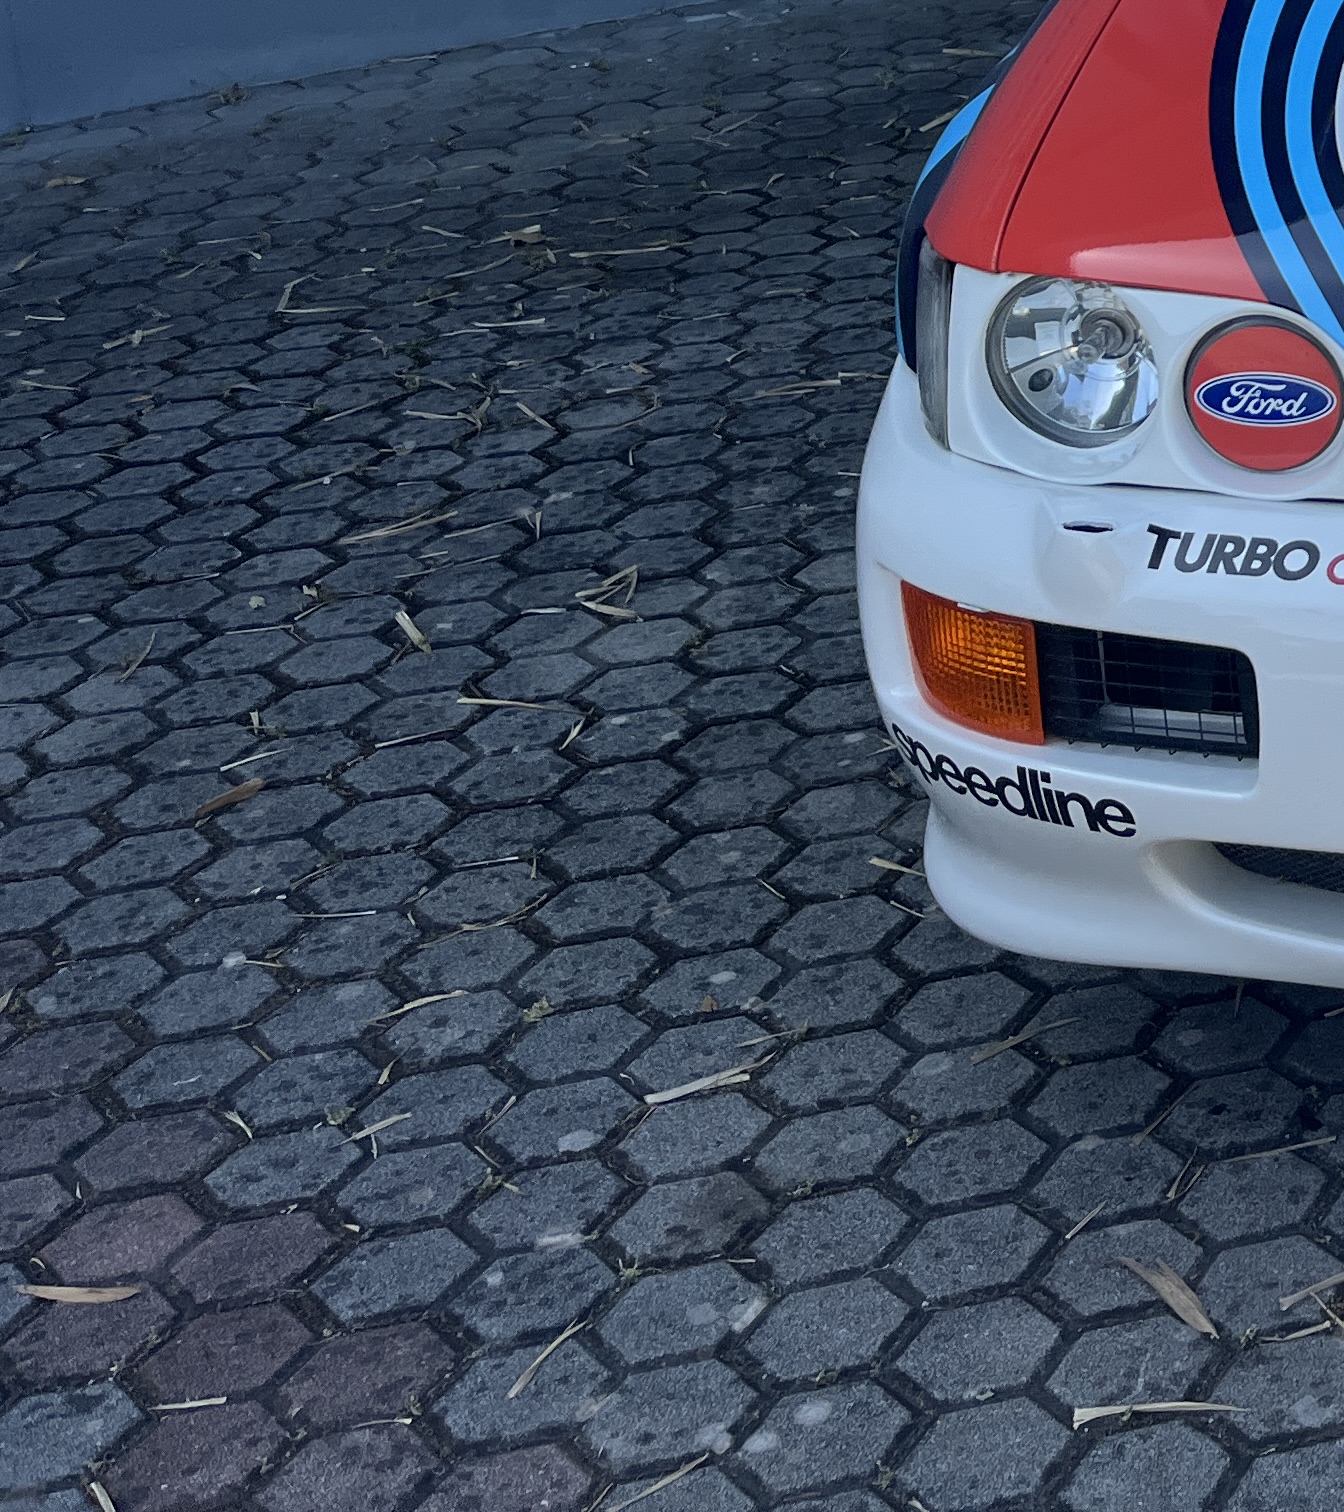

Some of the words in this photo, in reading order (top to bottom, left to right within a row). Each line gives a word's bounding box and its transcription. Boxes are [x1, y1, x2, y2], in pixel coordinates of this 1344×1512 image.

[1220, 380, 1309, 419] Ford
[1145, 523, 1320, 581] TURBO
[891, 723, 1137, 838] speedline
